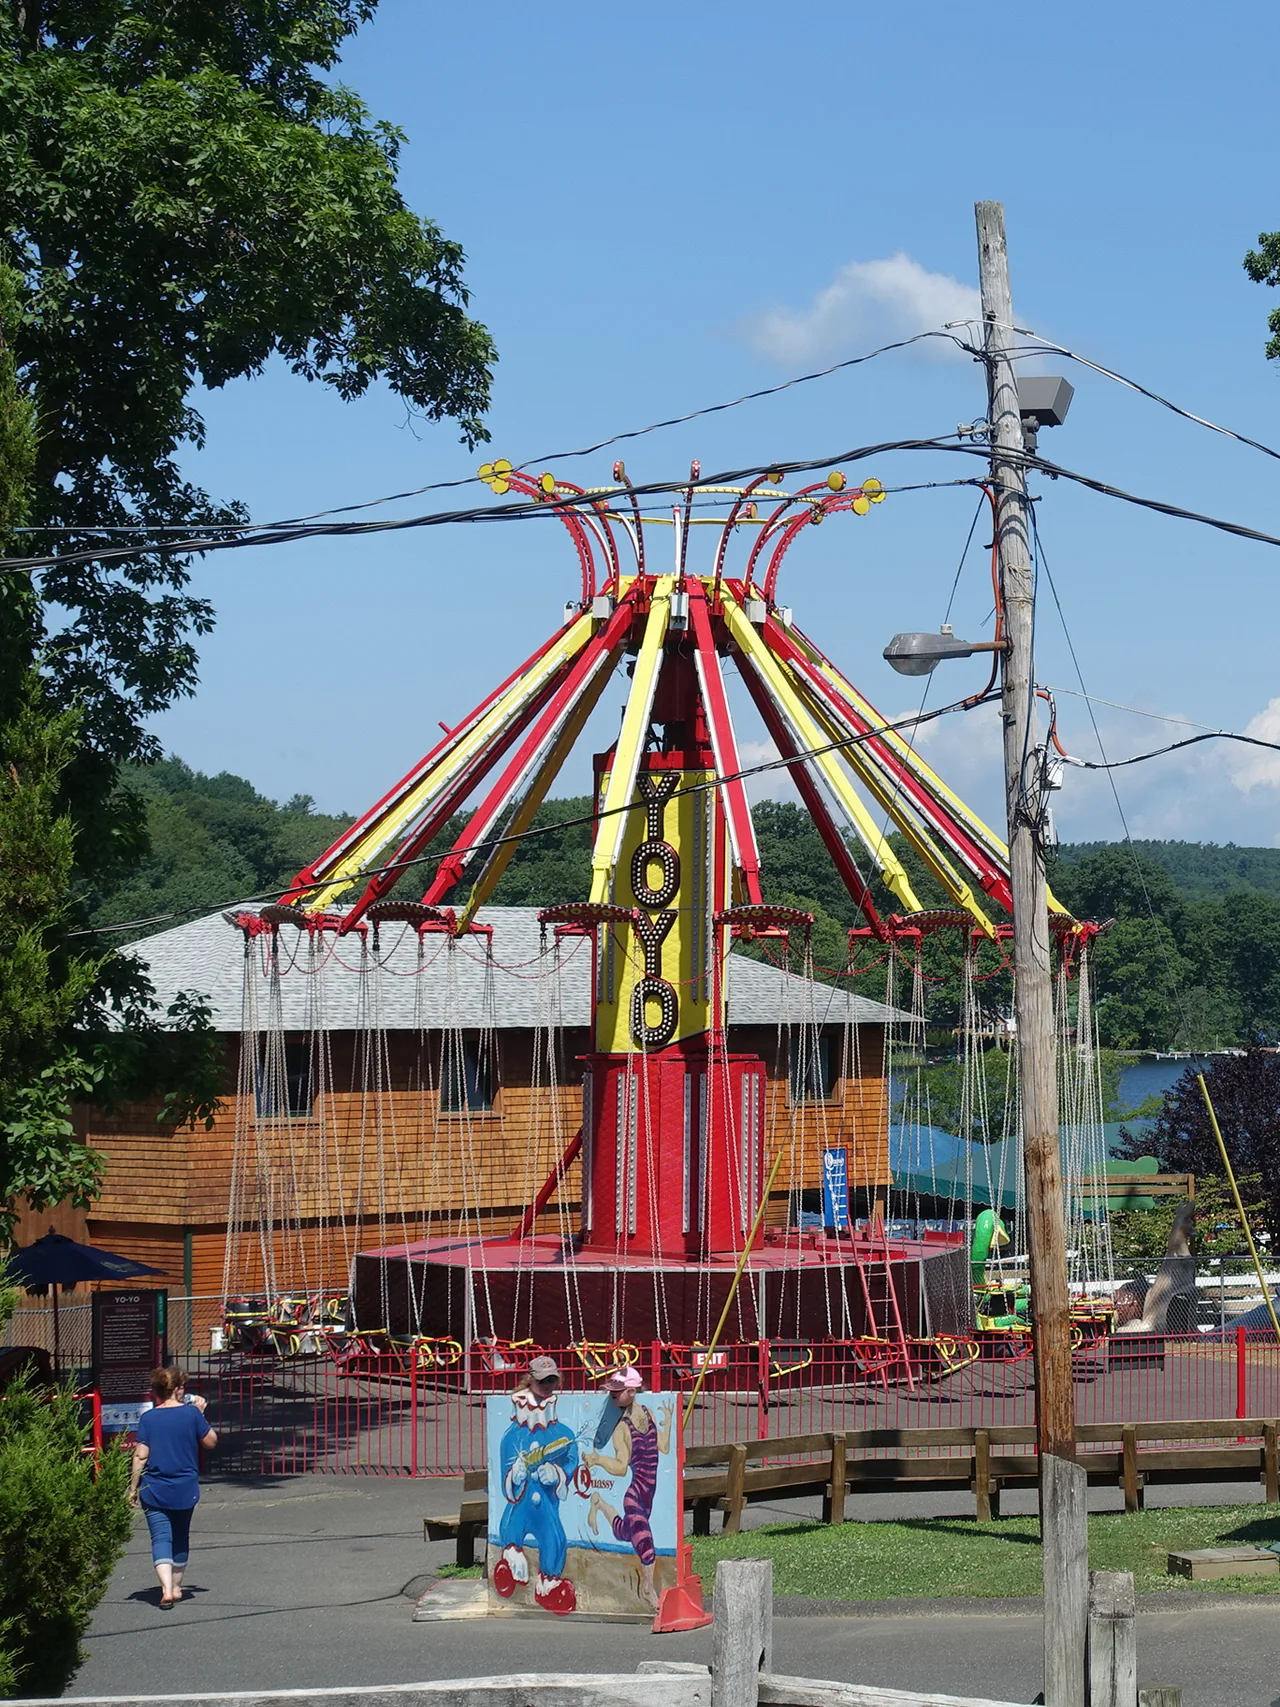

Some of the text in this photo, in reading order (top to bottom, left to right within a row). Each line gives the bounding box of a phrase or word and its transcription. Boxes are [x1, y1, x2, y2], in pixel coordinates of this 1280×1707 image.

[559, 906, 613, 917] YO-YO
[739, 908, 793, 920] YO-YO
[573, 1464, 615, 1499] Quassy
